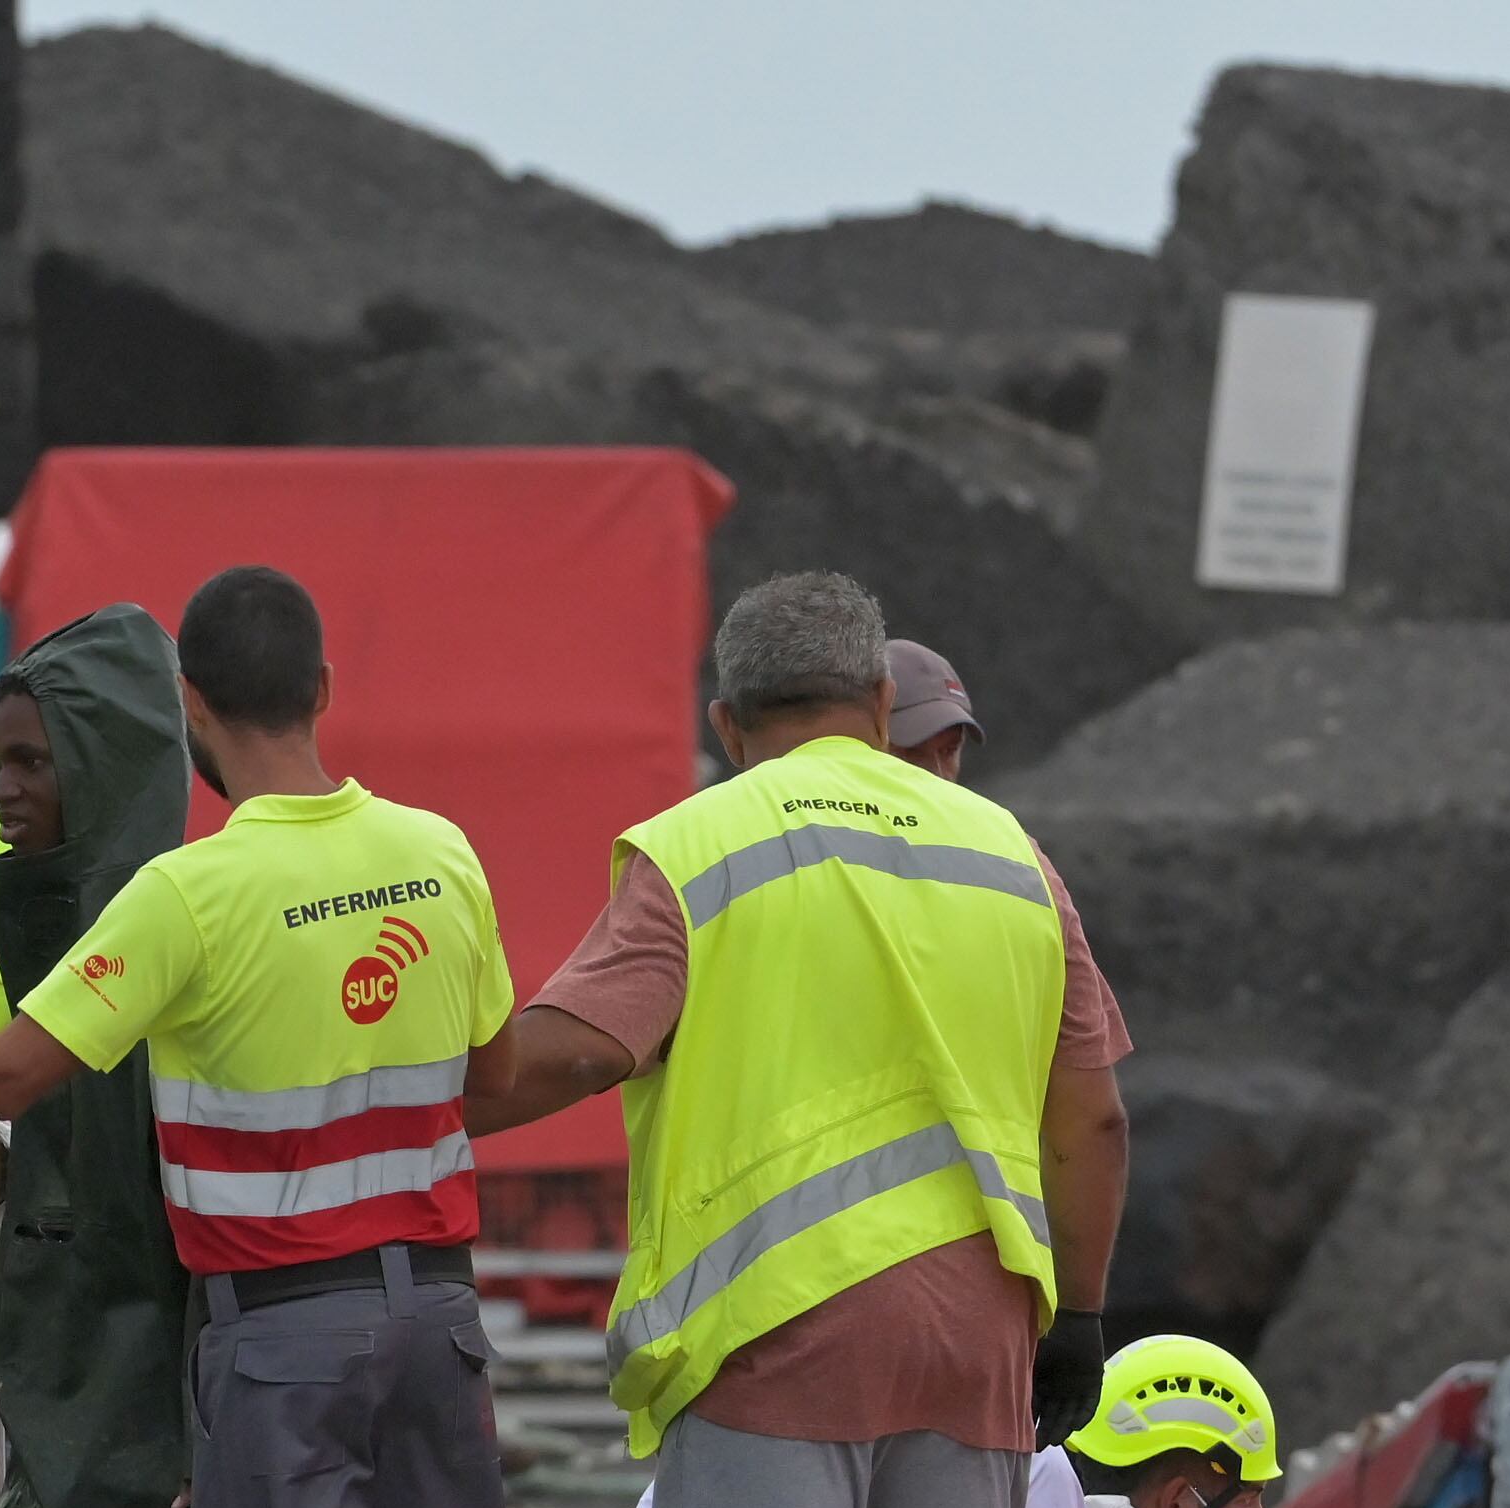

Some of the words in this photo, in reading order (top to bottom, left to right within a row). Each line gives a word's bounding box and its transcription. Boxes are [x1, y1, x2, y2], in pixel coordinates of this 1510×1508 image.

[782, 799, 919, 827] EMERGENAS
[283, 878, 442, 929] ENFERMERO
[86, 958, 106, 977] SUC
[346, 974, 396, 1010] SUC
